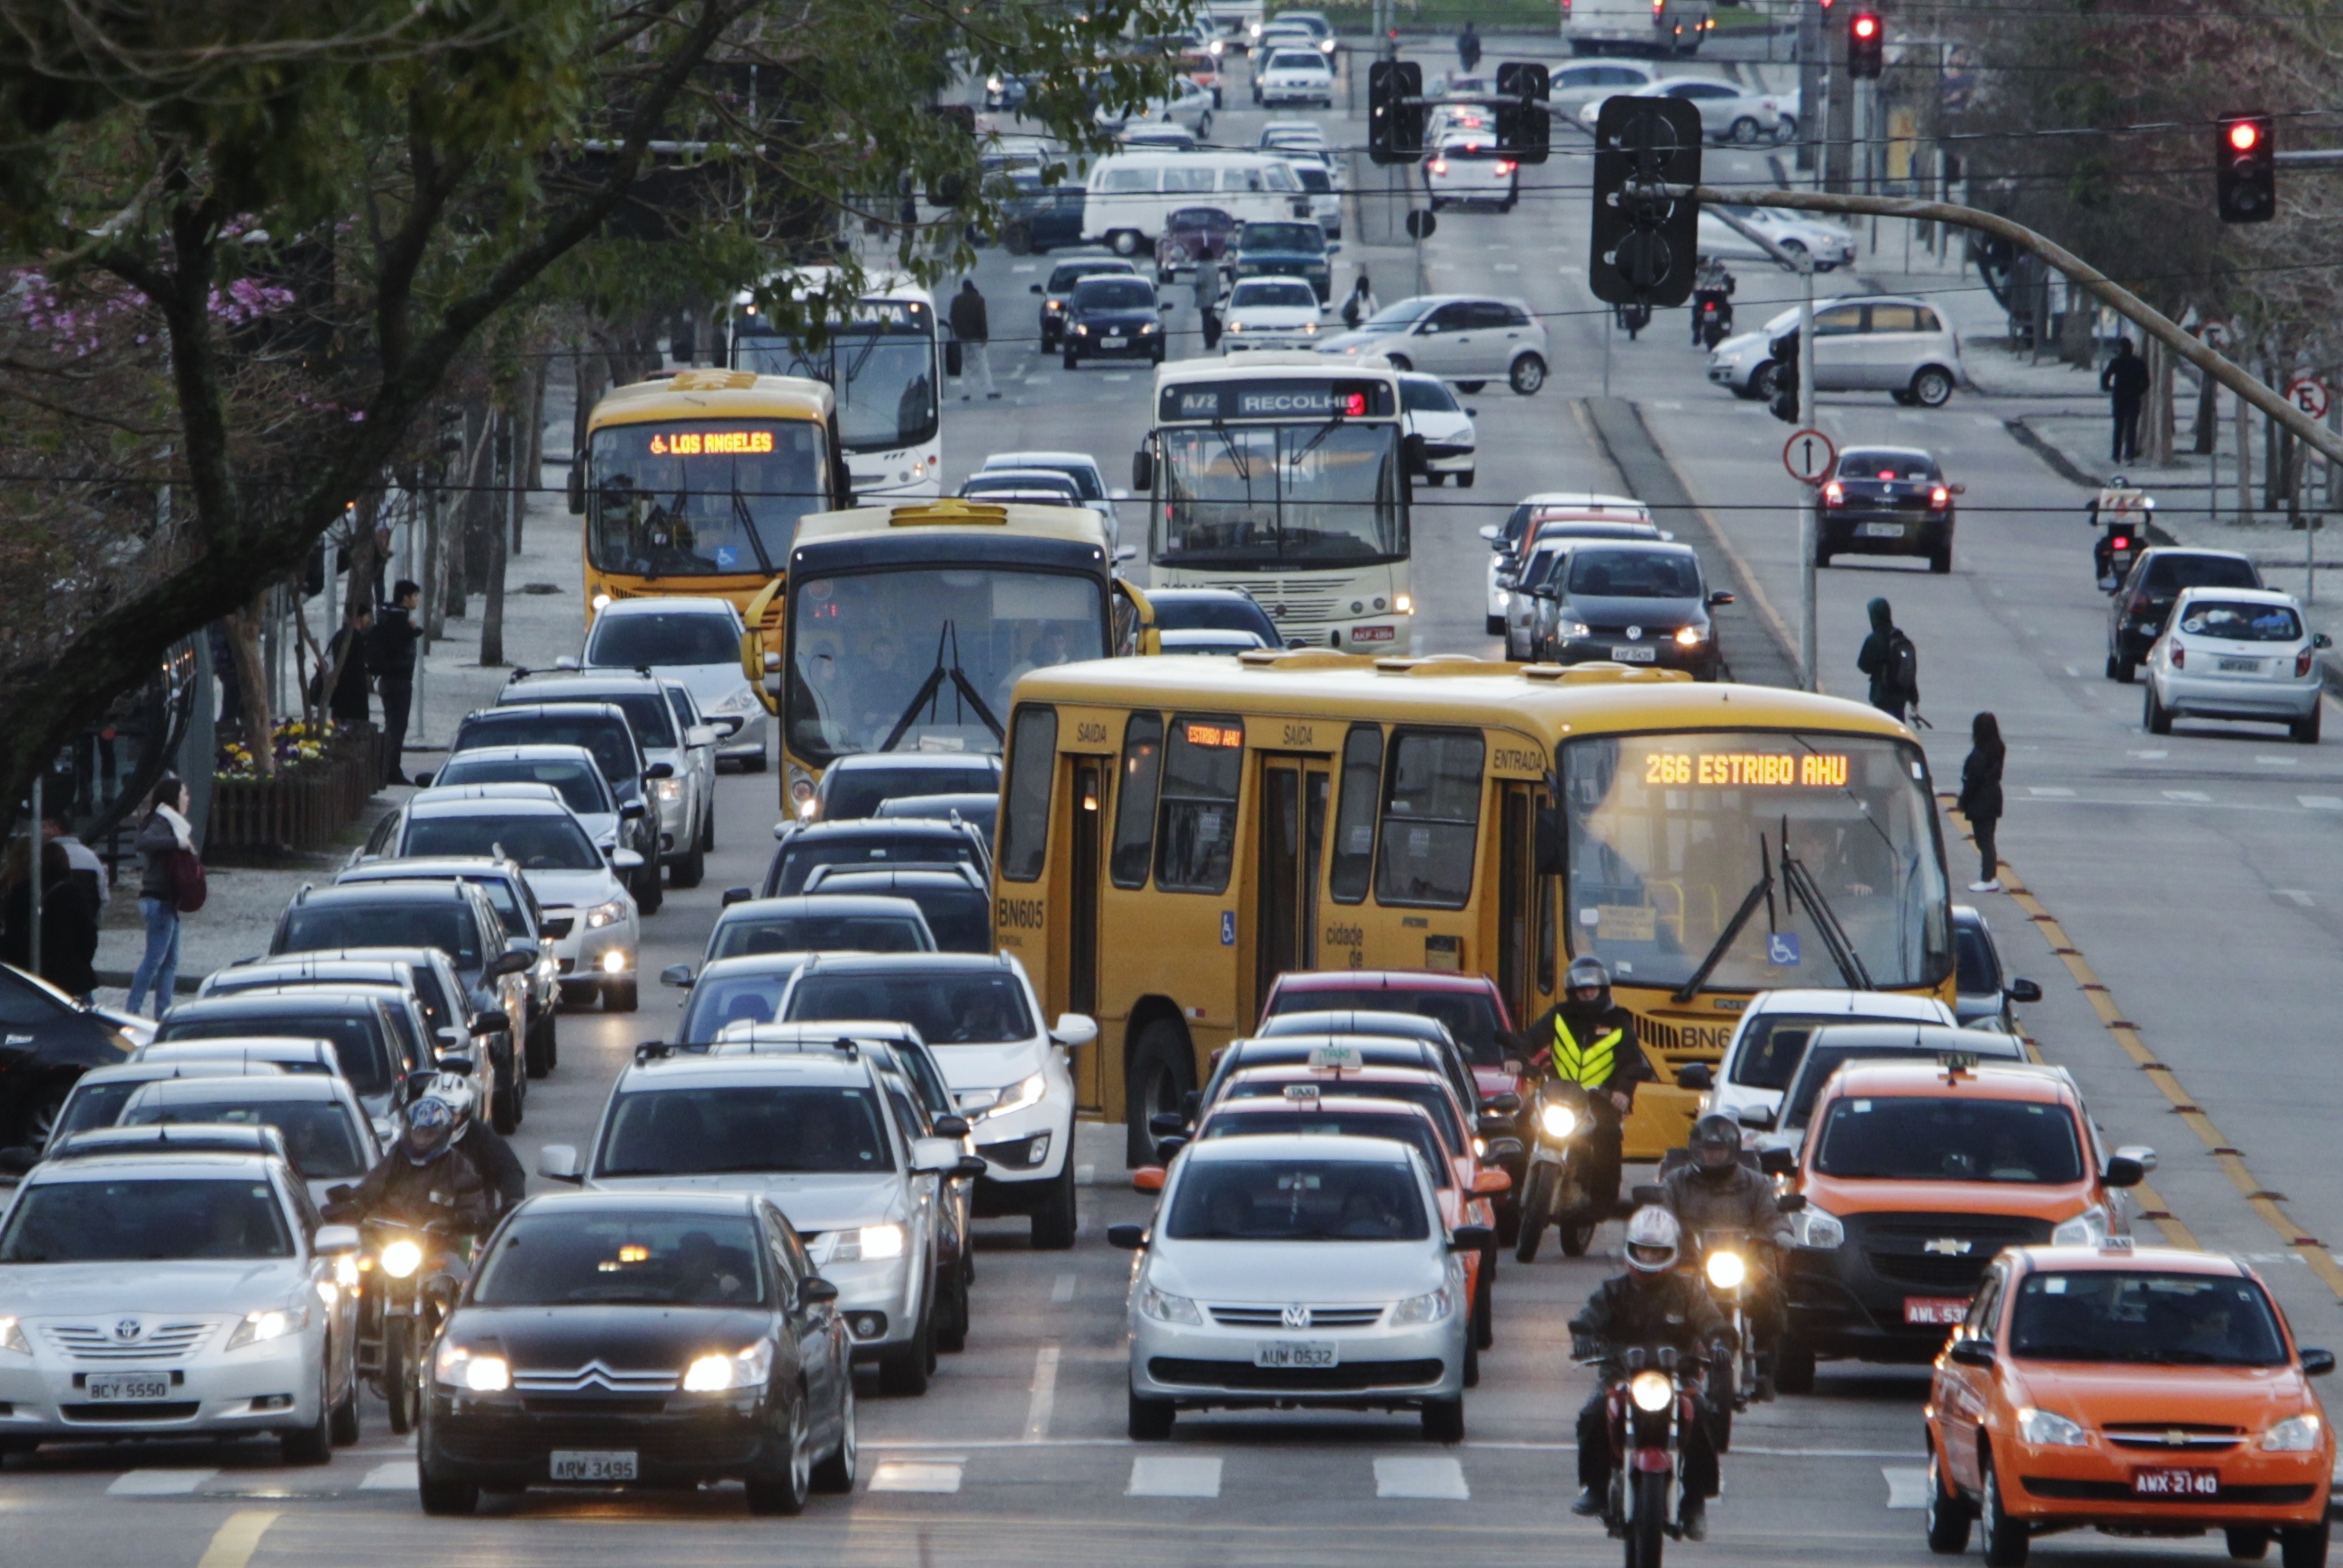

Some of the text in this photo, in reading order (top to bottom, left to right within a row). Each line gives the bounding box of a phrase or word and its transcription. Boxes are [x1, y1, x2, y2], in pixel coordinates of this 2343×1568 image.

[670, 432, 773, 454] LOS ANGELES
[1188, 725, 1241, 747] ESTRIBO AHU
[1492, 748, 1543, 771] ENTRADA
[1646, 753, 1848, 786] 266 ESTRIBO AHU
[998, 897, 1044, 930] BN605
[1326, 921, 1363, 947] cidade
[1320, 1048, 1351, 1059] TAXI
[1290, 1086, 1316, 1096] TAXI
[2104, 1237, 2131, 1248] TAXI
